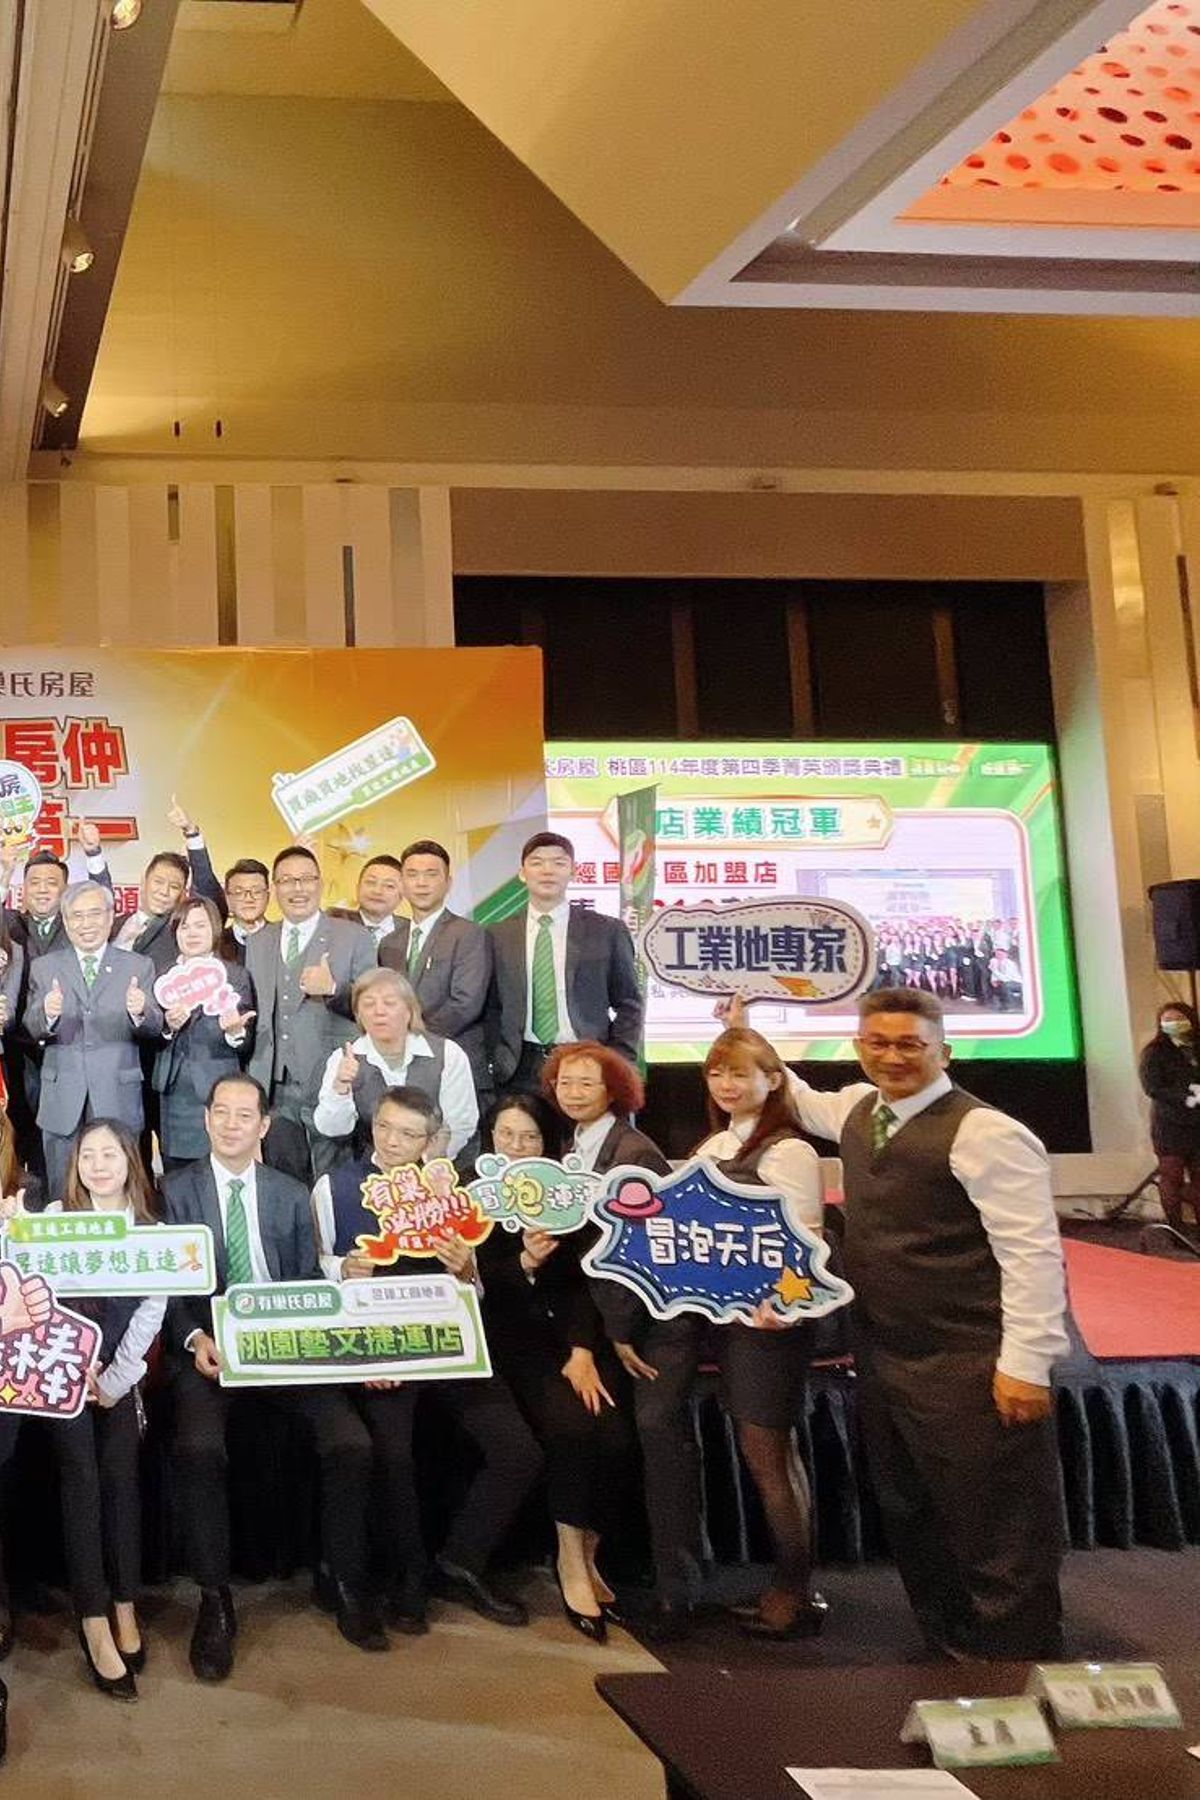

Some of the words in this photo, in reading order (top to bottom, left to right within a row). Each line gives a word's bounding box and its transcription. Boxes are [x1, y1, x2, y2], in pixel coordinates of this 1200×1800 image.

[655, 807, 842, 838] 店業績冠軍
[664, 926, 847, 973] 工業地專家
[645, 1217, 785, 1268] 冒泡天后
[257, 1292, 334, 1311] 有巢氏房屋
[238, 1322, 463, 1362] 桃園藝文捷運店
